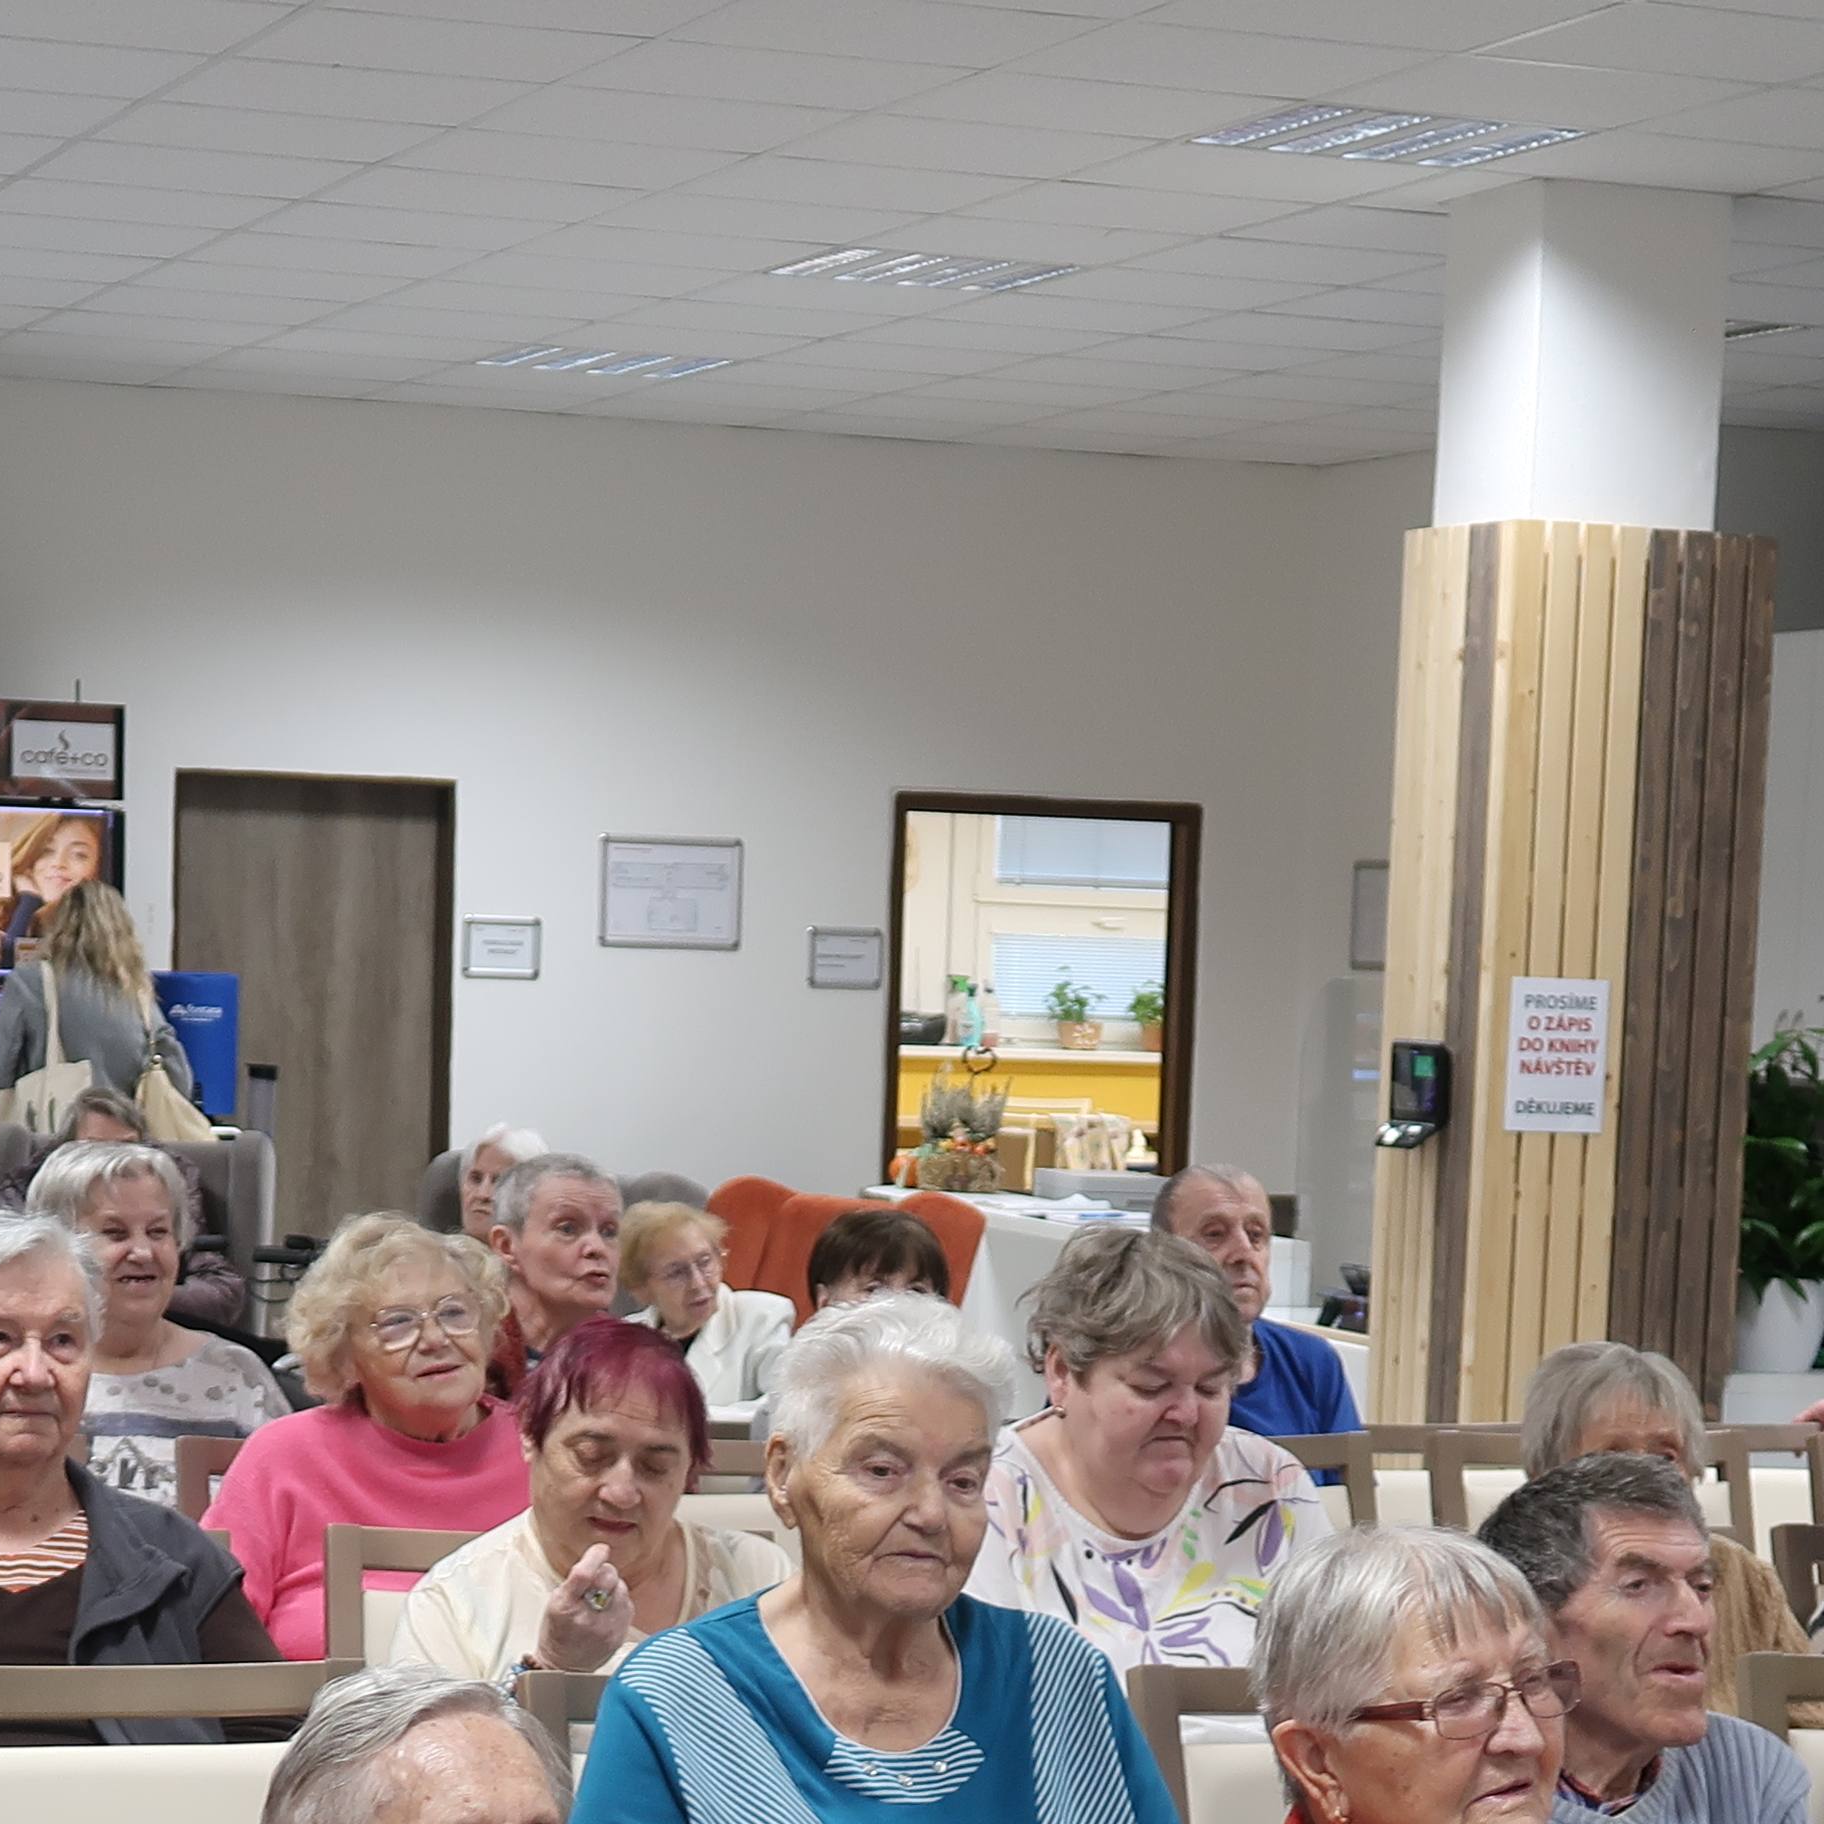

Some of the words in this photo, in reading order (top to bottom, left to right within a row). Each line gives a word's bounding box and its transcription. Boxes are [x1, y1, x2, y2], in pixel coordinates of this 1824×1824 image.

[1524, 992, 1598, 1010] PROSÍME
[1528, 1015, 1541, 1030] O
[1544, 1013, 1593, 1032] ZÁPIS
[1519, 1037, 1544, 1051] DO
[1547, 1038, 1600, 1054] KNIHY
[1519, 1057, 1596, 1076] NÁVŠTĚV
[1514, 1097, 1596, 1116] DĚKUJEME
